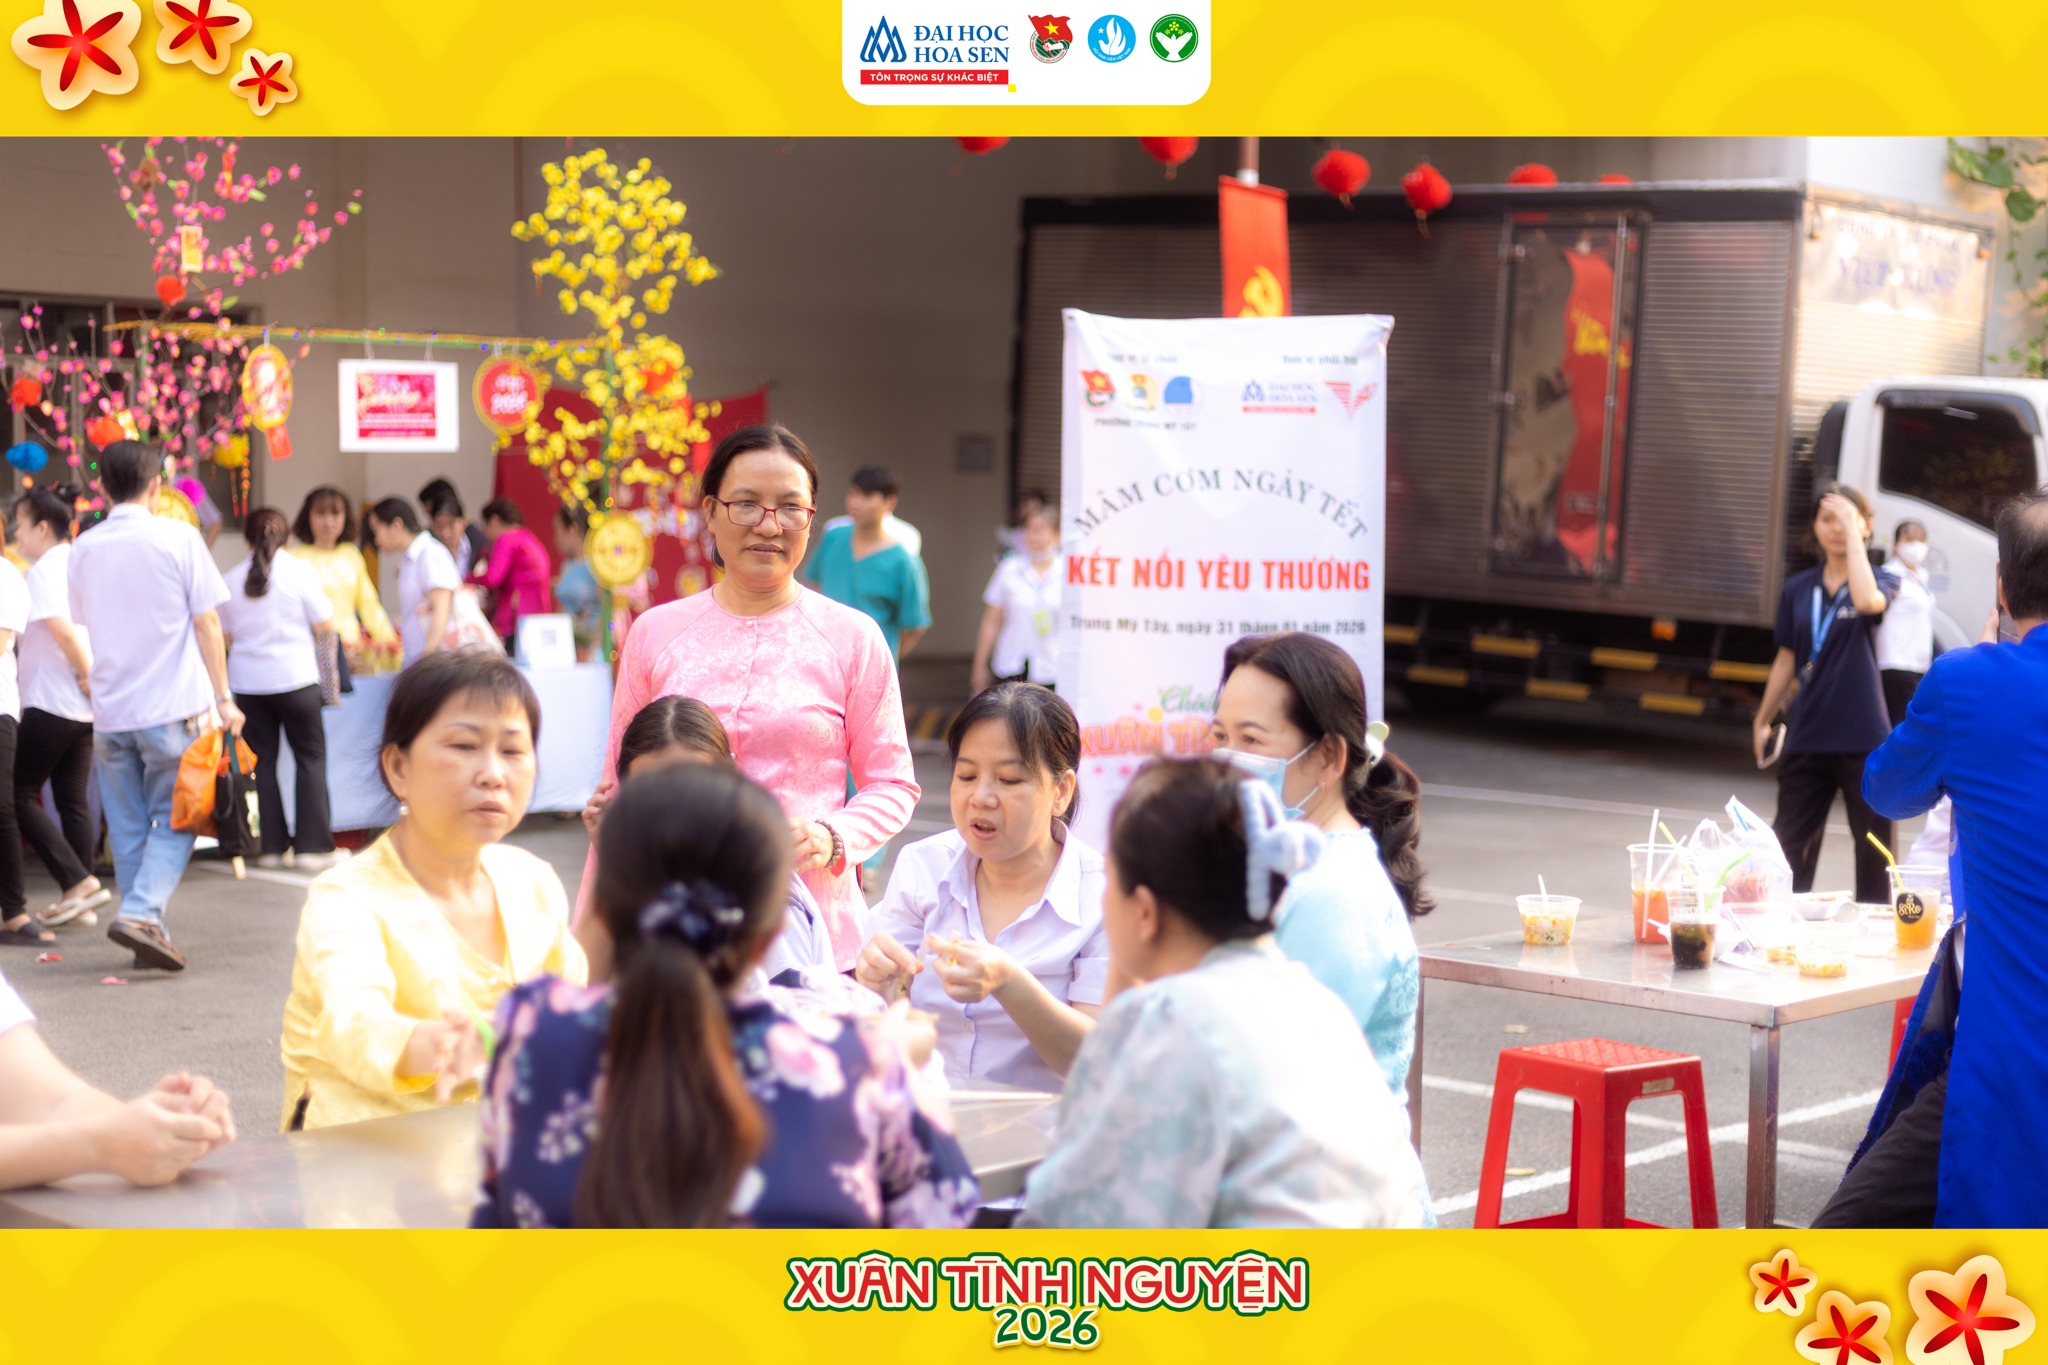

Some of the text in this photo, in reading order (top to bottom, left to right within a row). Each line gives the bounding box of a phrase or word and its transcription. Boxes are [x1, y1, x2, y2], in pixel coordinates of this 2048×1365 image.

[1153, 467, 1221, 497] CƠM
[1233, 467, 1314, 503] NGÀY
[1319, 491, 1368, 540] TẾT
[1067, 545, 1371, 591] KẾT NỐI YÊU THƯƠNG
[1071, 615, 1111, 630] Trung
[1177, 620, 1212, 635] ngày
[1218, 621, 1233, 634] 31
